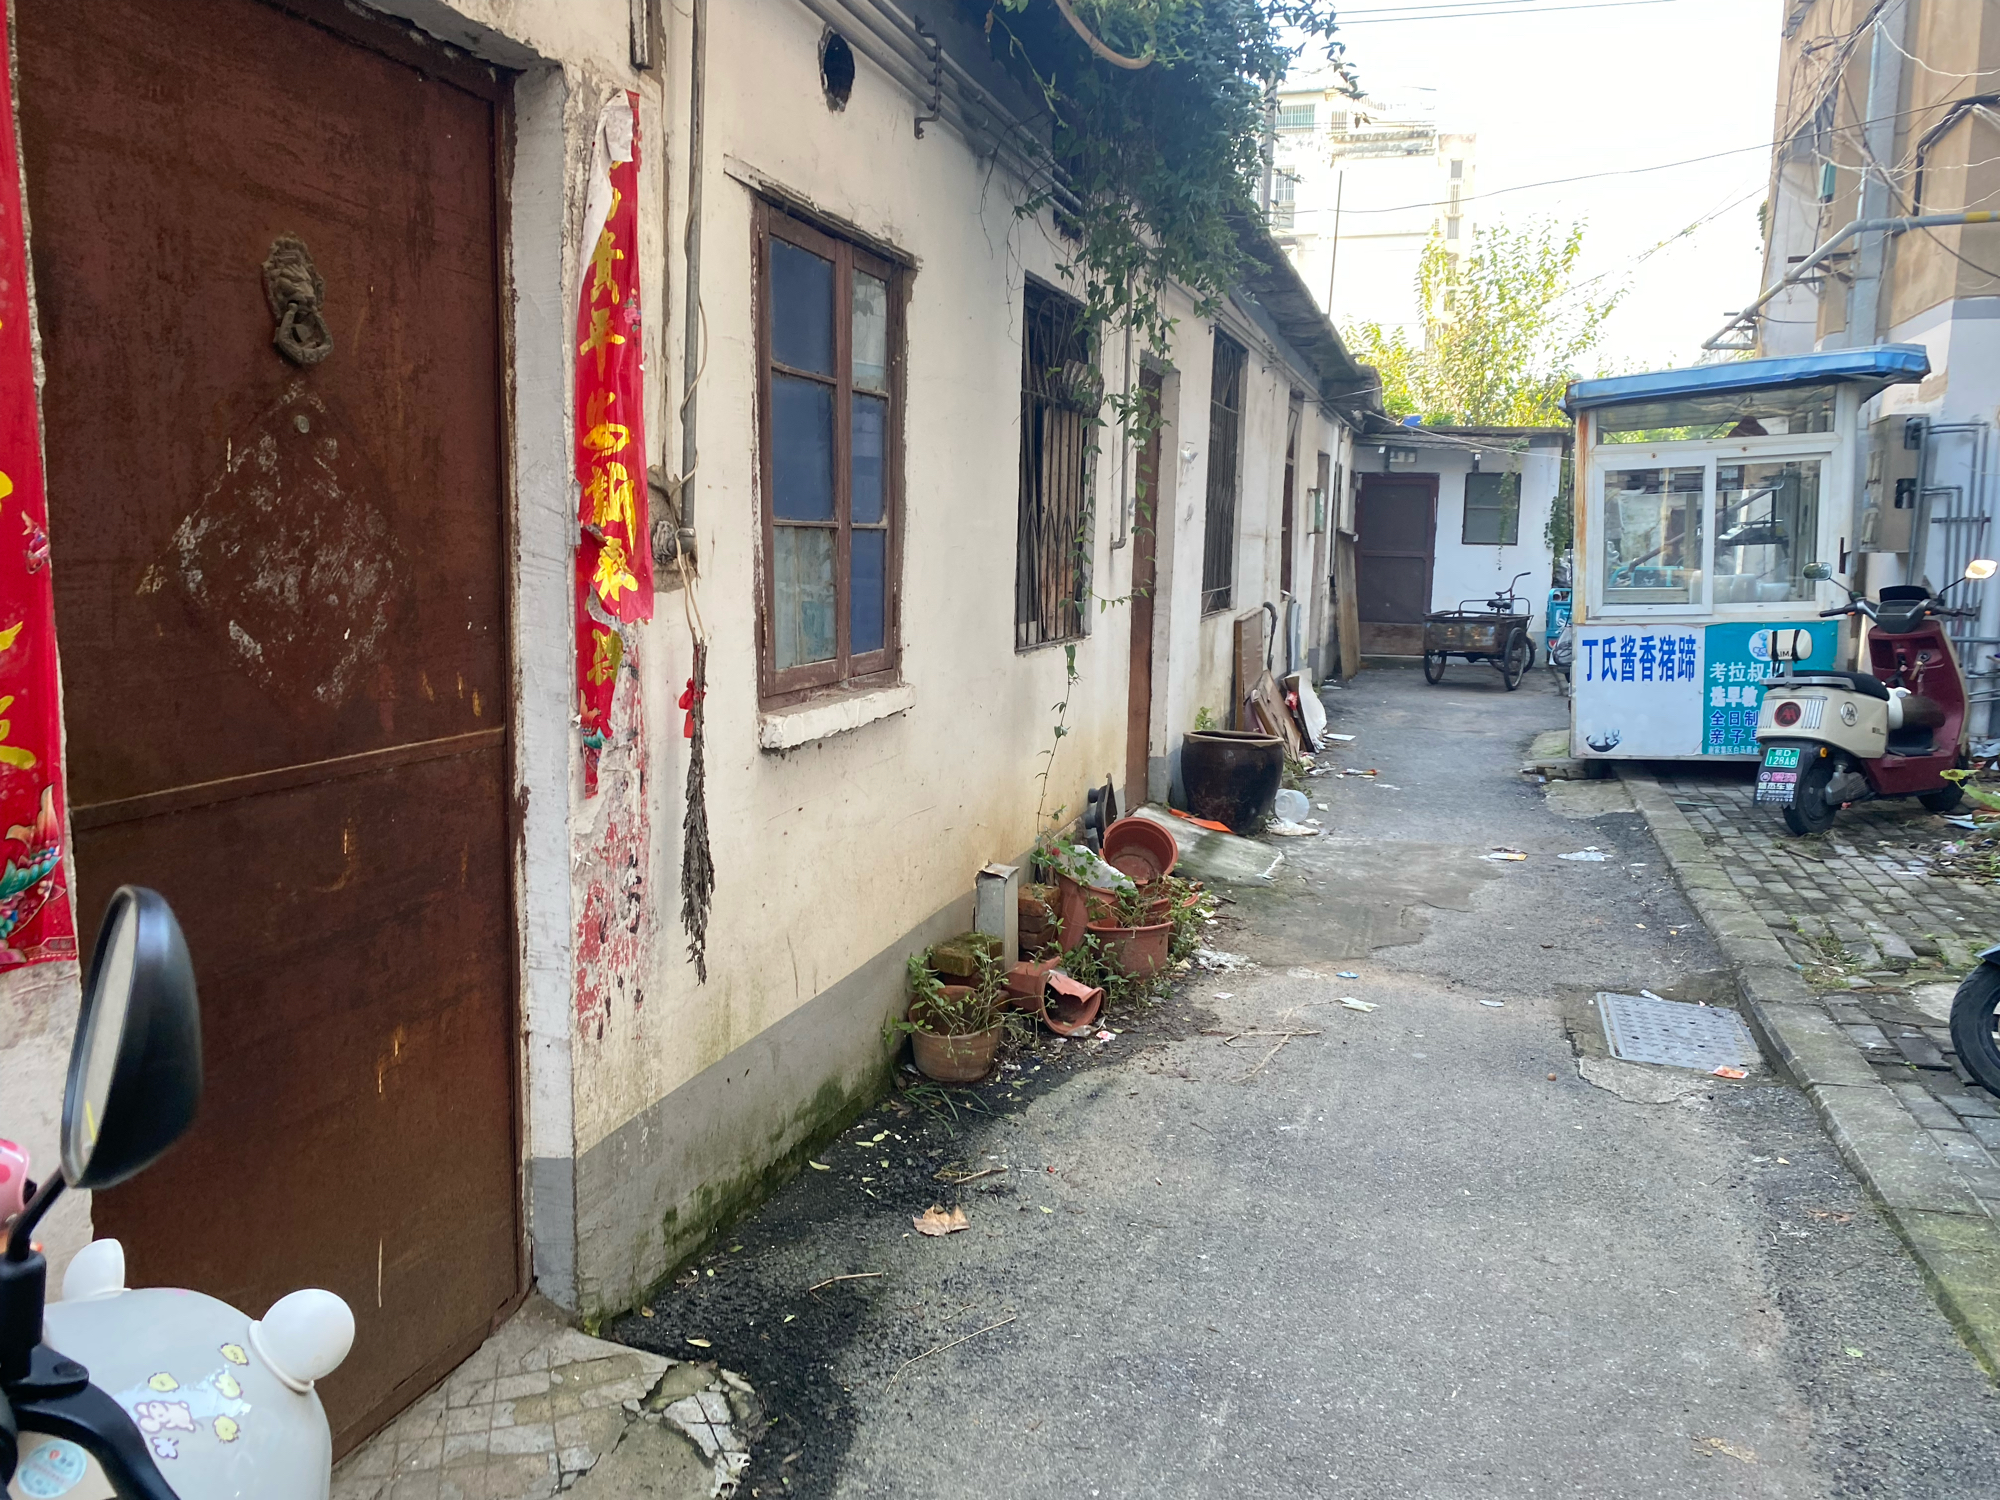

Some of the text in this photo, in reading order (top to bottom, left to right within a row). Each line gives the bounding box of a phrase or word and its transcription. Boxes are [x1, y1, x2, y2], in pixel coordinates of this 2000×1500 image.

[1581, 634, 1697, 682] 丁氏酱香猪蹄
[1709, 709, 1759, 727] 全日制
